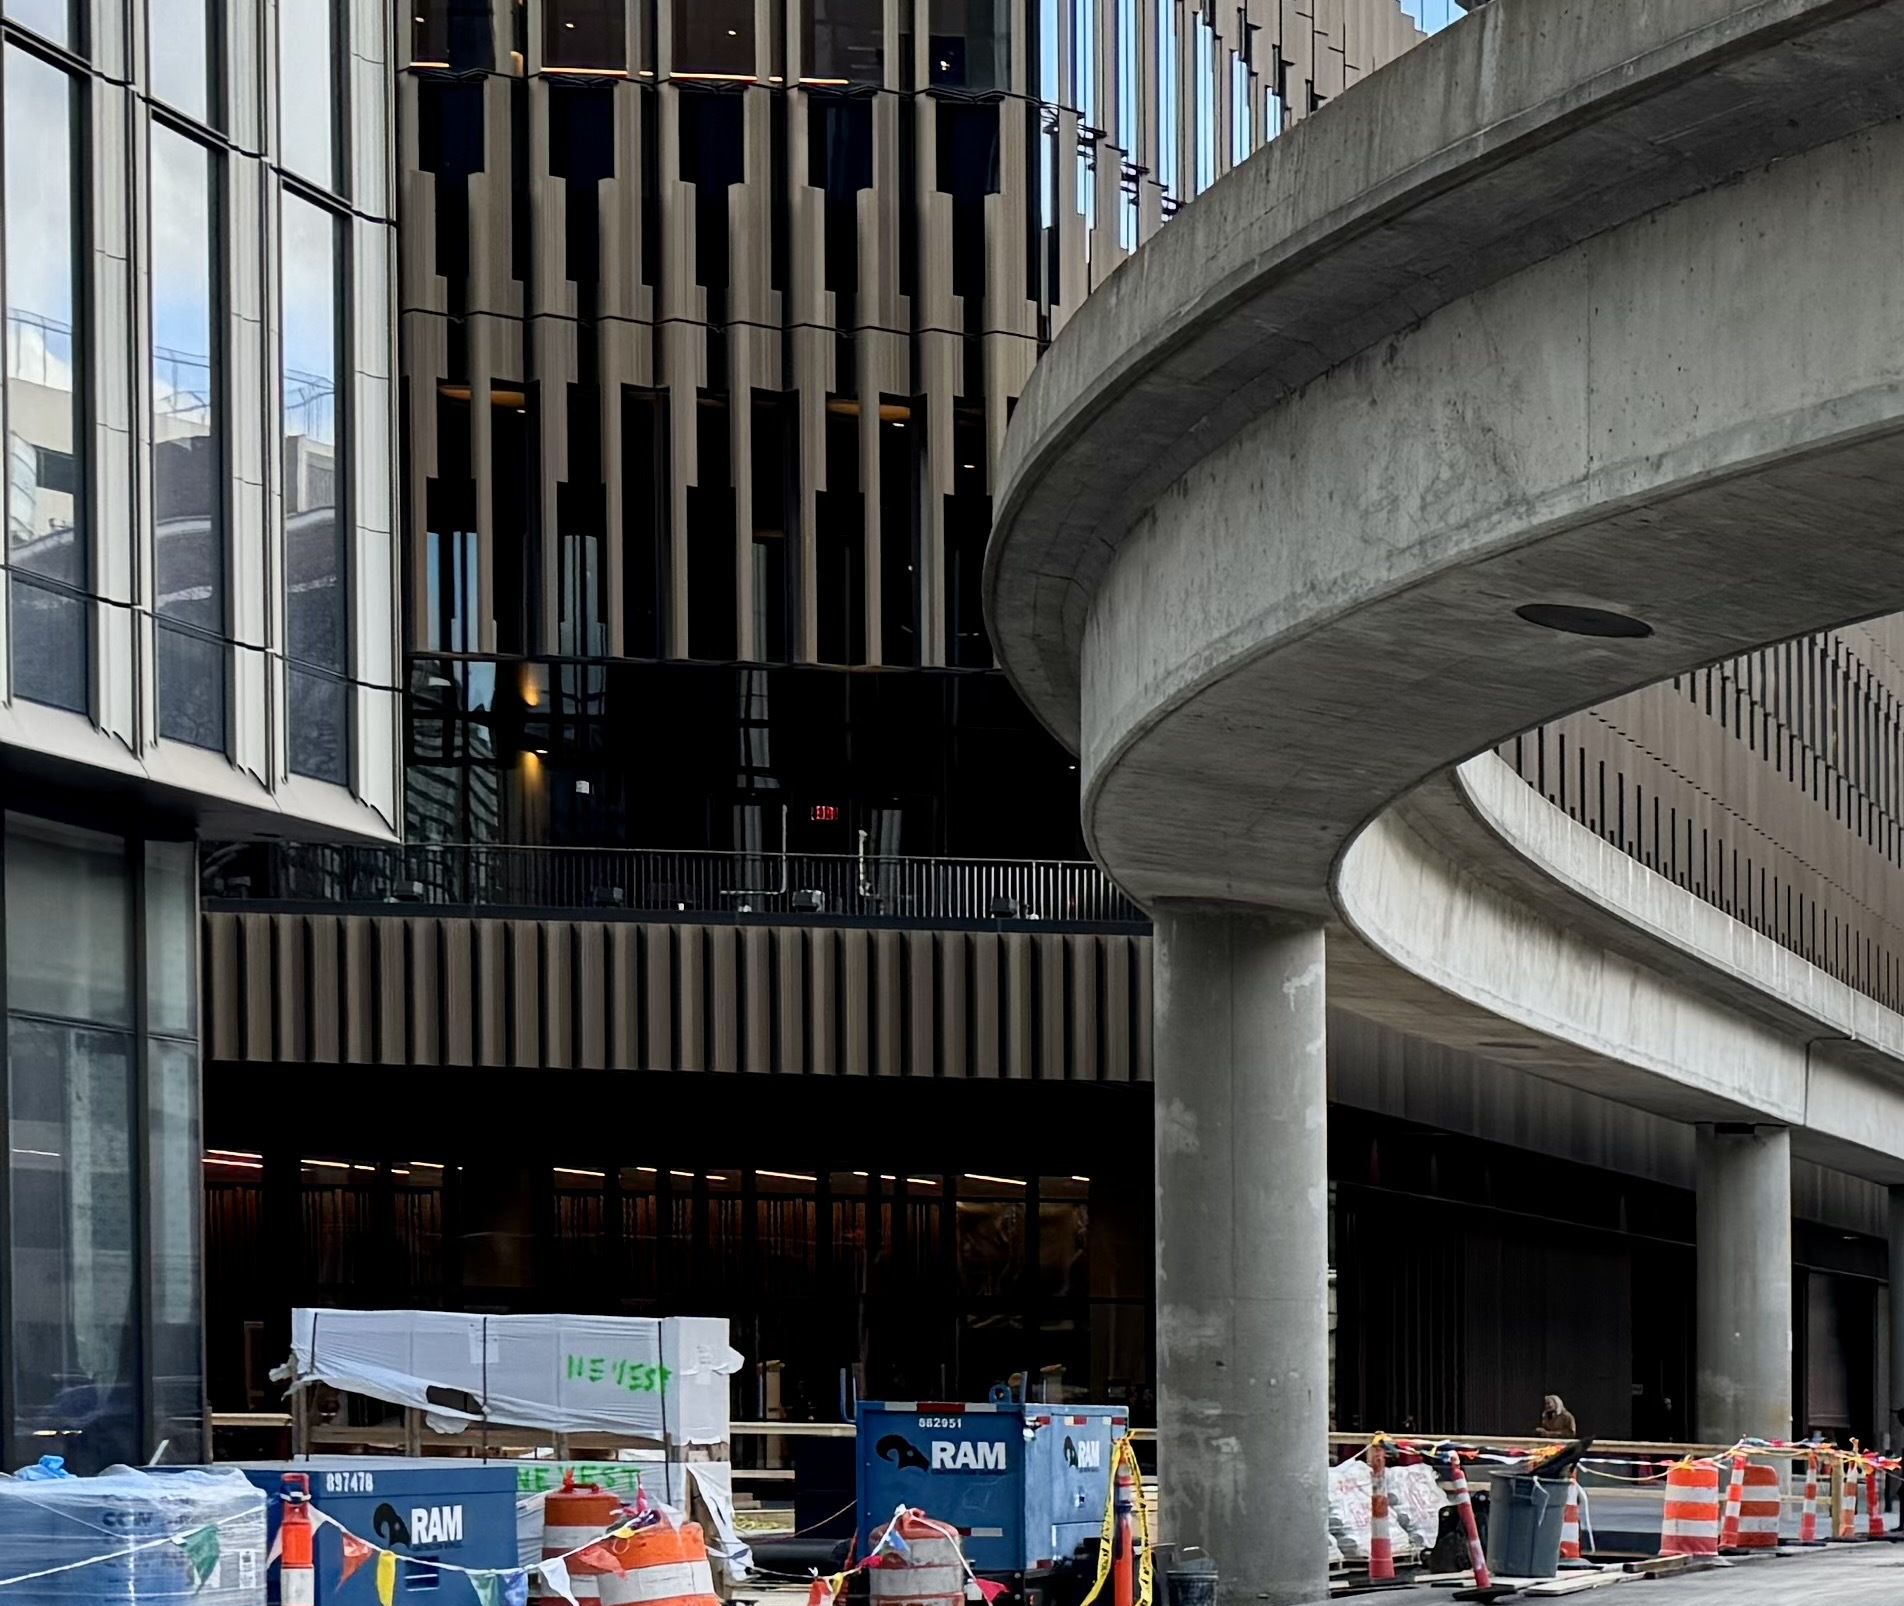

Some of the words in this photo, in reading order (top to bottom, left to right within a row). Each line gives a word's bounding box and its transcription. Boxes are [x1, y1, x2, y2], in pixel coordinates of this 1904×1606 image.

[931, 1441, 1007, 1470] RAM
[1077, 1440, 1100, 1468] RAM
[411, 1504, 463, 1545] RAM
